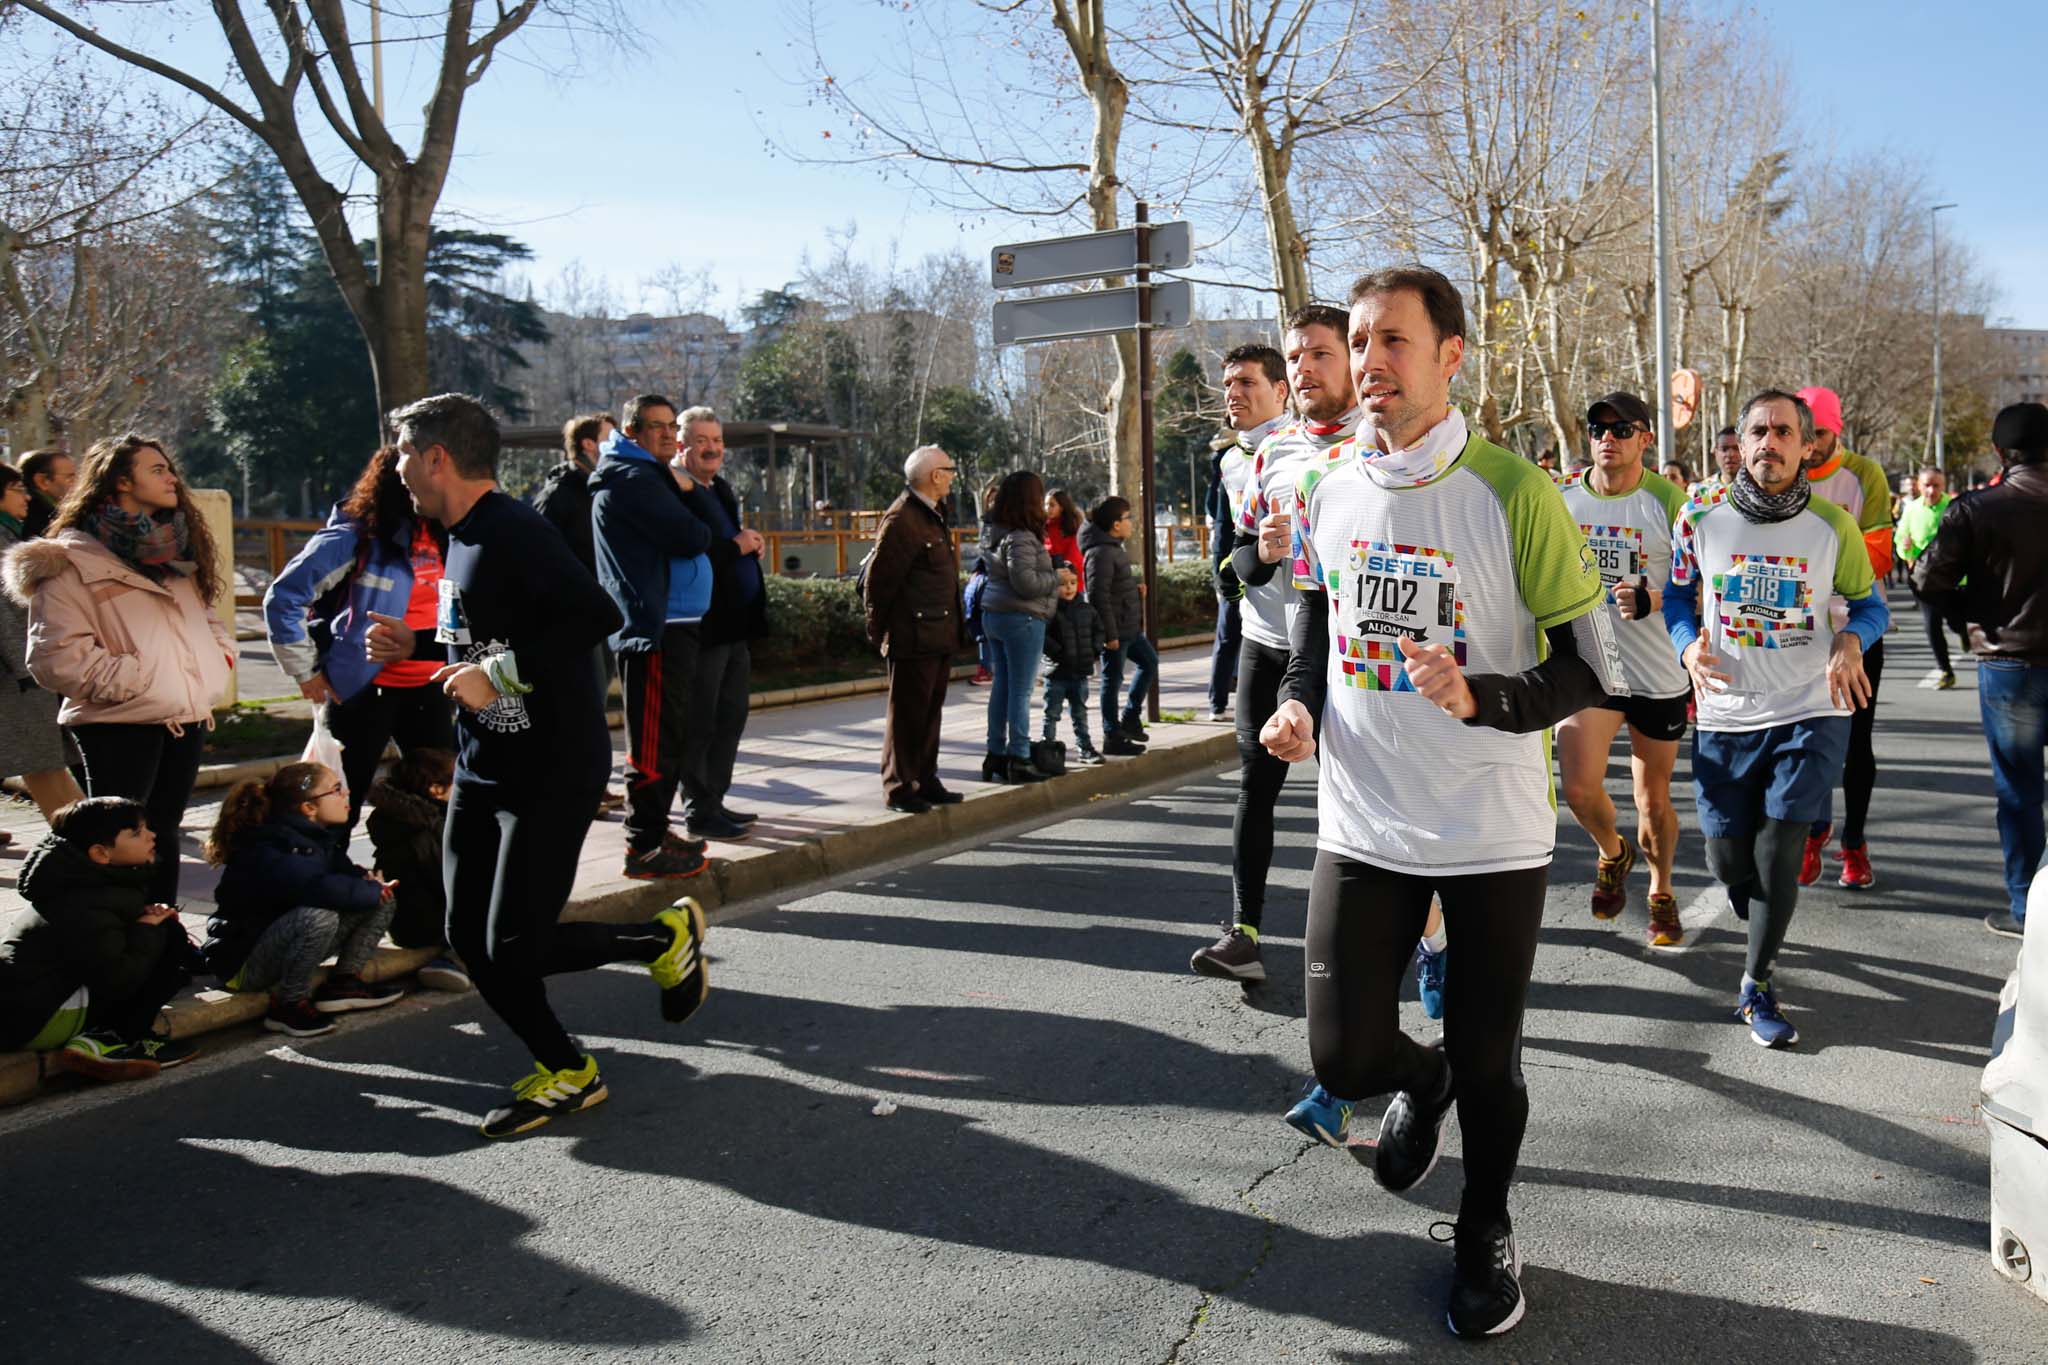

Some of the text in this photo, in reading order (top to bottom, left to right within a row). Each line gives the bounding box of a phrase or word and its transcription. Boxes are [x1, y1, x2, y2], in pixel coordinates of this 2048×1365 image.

[1589, 539, 1632, 550] SETEL
[1368, 556, 1442, 578] SETEL
[1747, 564, 1798, 578] SETEL
[1357, 574, 1418, 616] 1702
[1740, 576, 1780, 603] 5118
[1362, 610, 1410, 623] HECTOR-SAN
[1745, 605, 1779, 619] ALJOMAR
[1368, 622, 1416, 640] ALJOMAR
